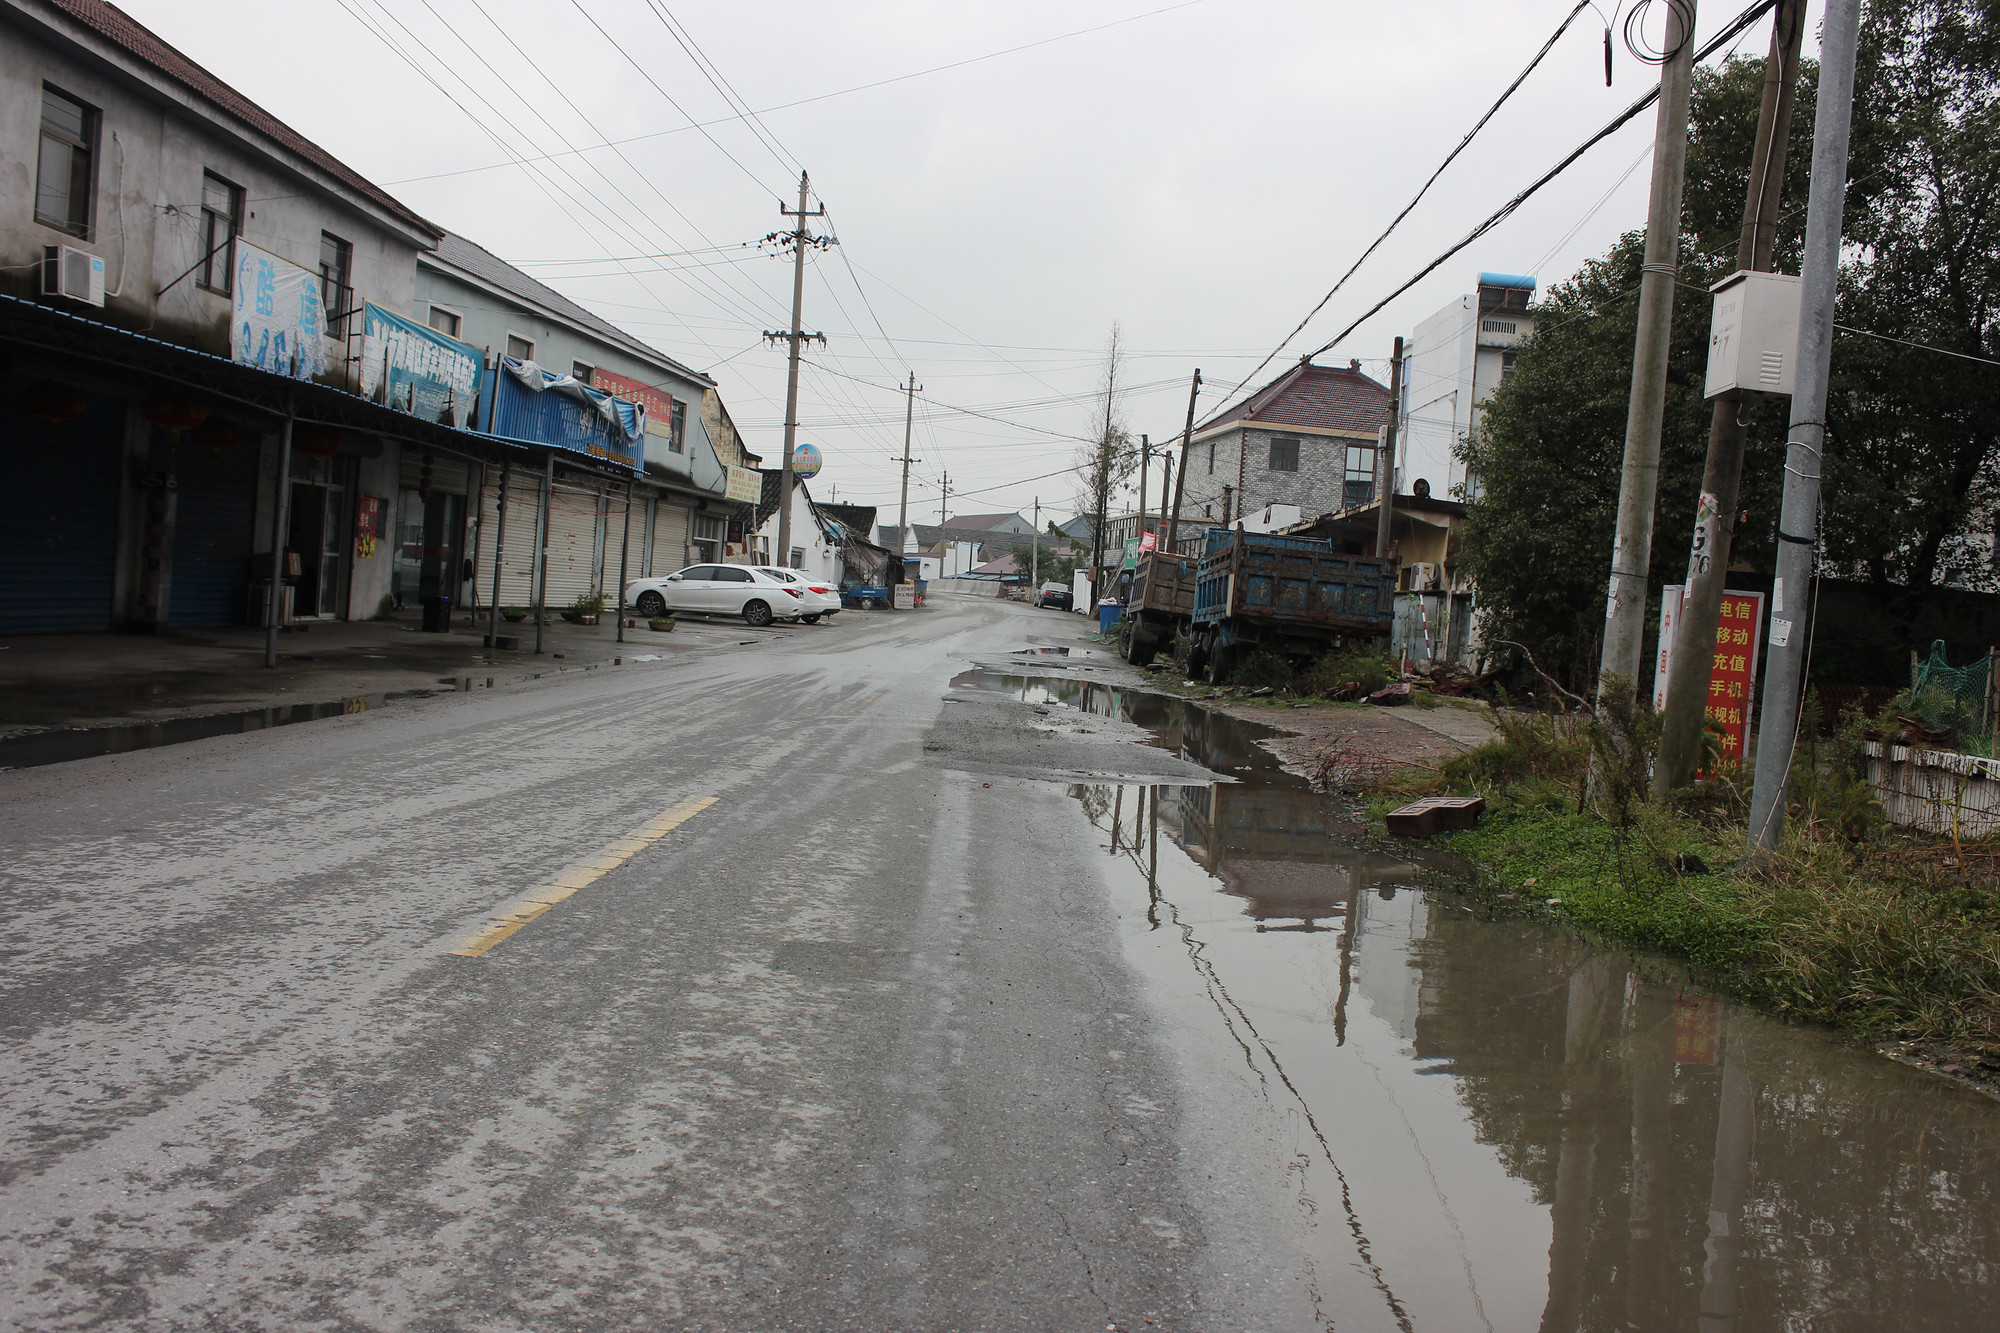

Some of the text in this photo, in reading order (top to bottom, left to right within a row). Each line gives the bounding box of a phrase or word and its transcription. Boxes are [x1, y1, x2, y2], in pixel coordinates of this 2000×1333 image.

[1720, 601, 1751, 619] 电信
[1716, 626, 1749, 645] 移动
[1712, 654, 1746, 672] 充值
[1709, 680, 1743, 698] 手机
